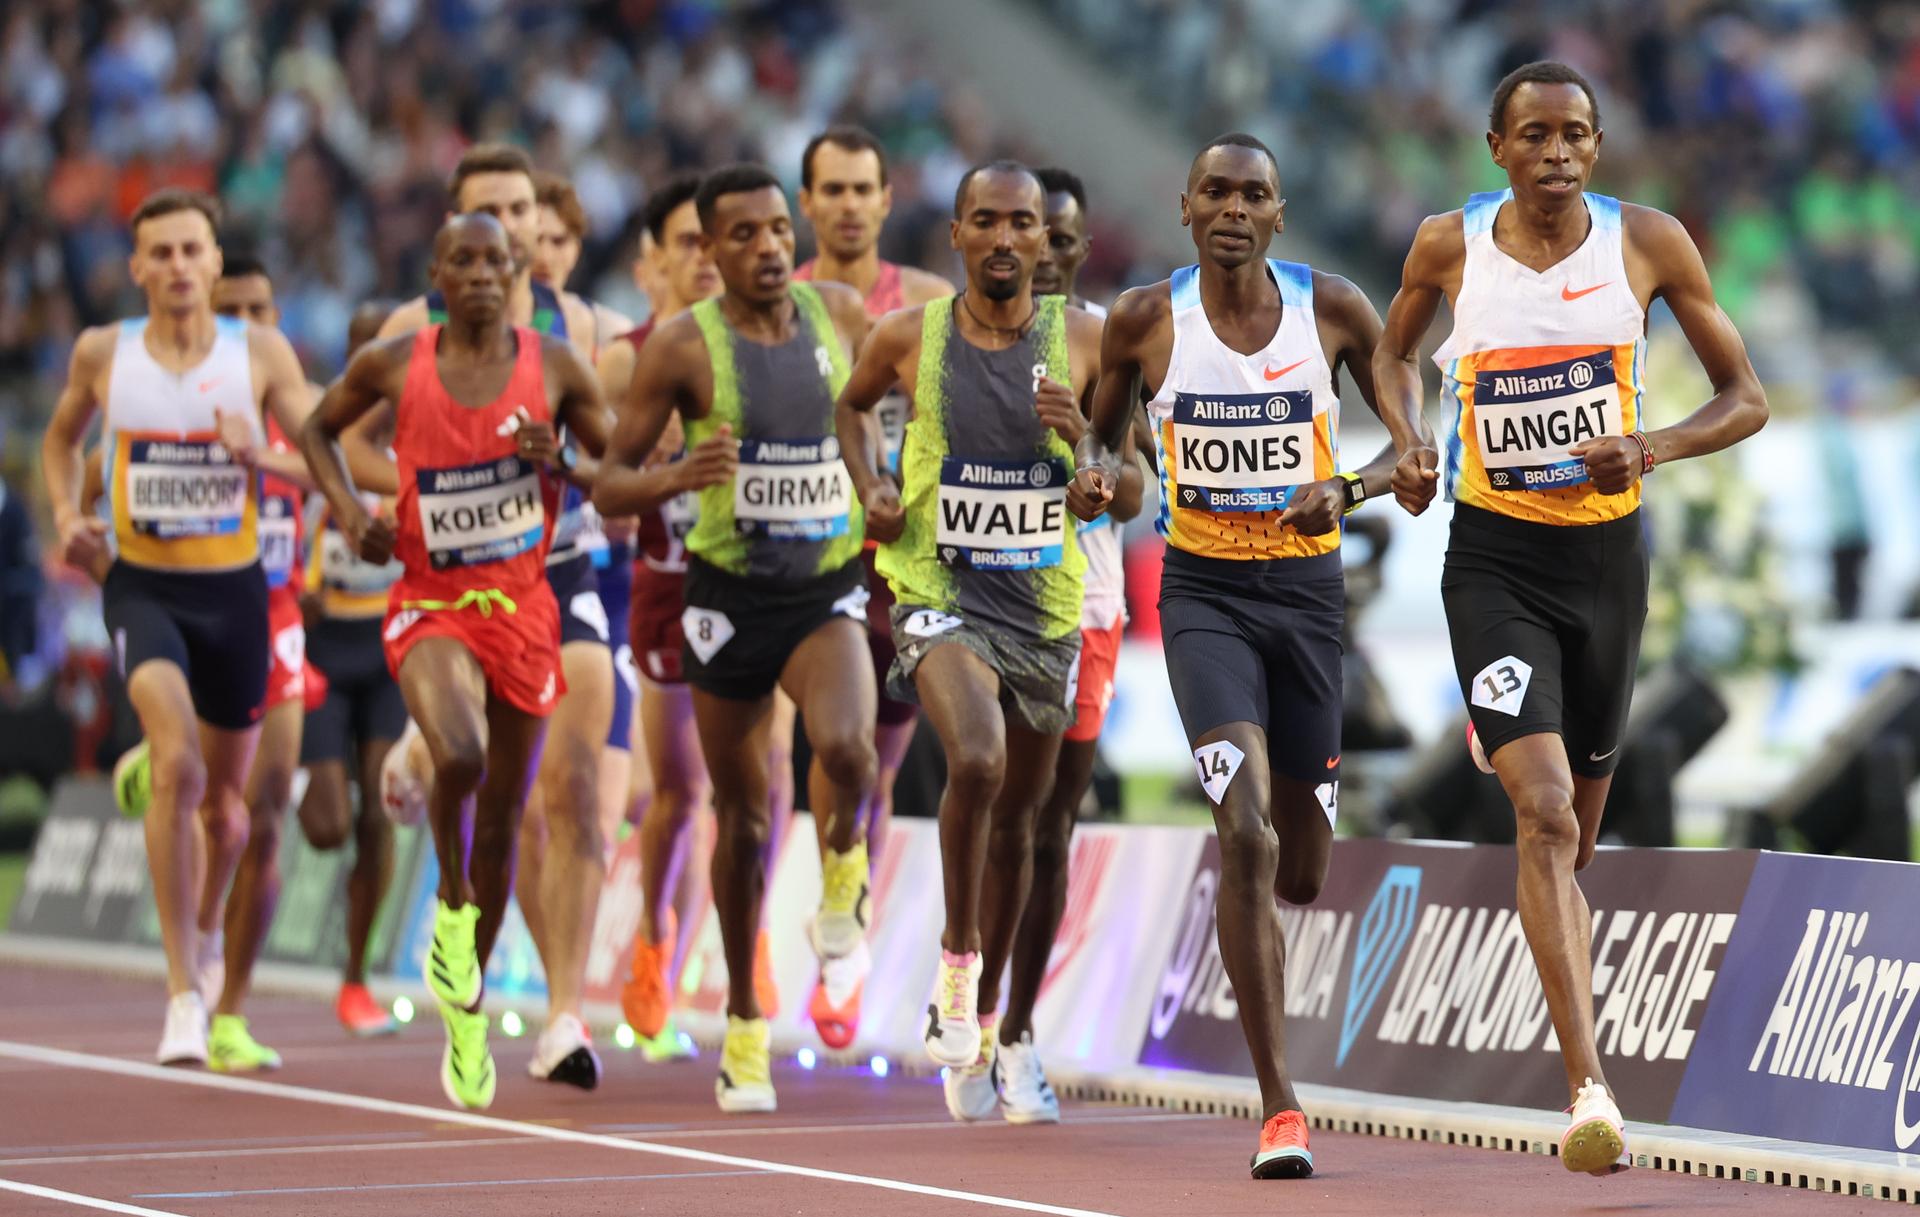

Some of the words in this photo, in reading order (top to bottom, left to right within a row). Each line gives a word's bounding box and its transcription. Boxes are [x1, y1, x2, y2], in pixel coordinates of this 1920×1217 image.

[1494, 372, 1566, 396] Allianz
[1193, 400, 1262, 420] Allianz
[1483, 399, 1607, 454] LANGAT
[756, 441, 819, 462] Allianz
[1181, 435, 1301, 473] KONES
[434, 468, 495, 492] Allianz
[960, 463, 1026, 485] Allianz
[1523, 464, 1588, 485] BRUSSE
[743, 474, 843, 506] GIRMA
[1210, 491, 1285, 506] BRUSSELS
[430, 490, 535, 535] KOECH
[942, 498, 1063, 535] WALE
[971, 550, 1041, 566] BRUSSELS
[698, 616, 714, 642] 8
[1482, 665, 1522, 703] 13
[1198, 750, 1230, 784] 14
[1748, 908, 1920, 1091] Allianz
